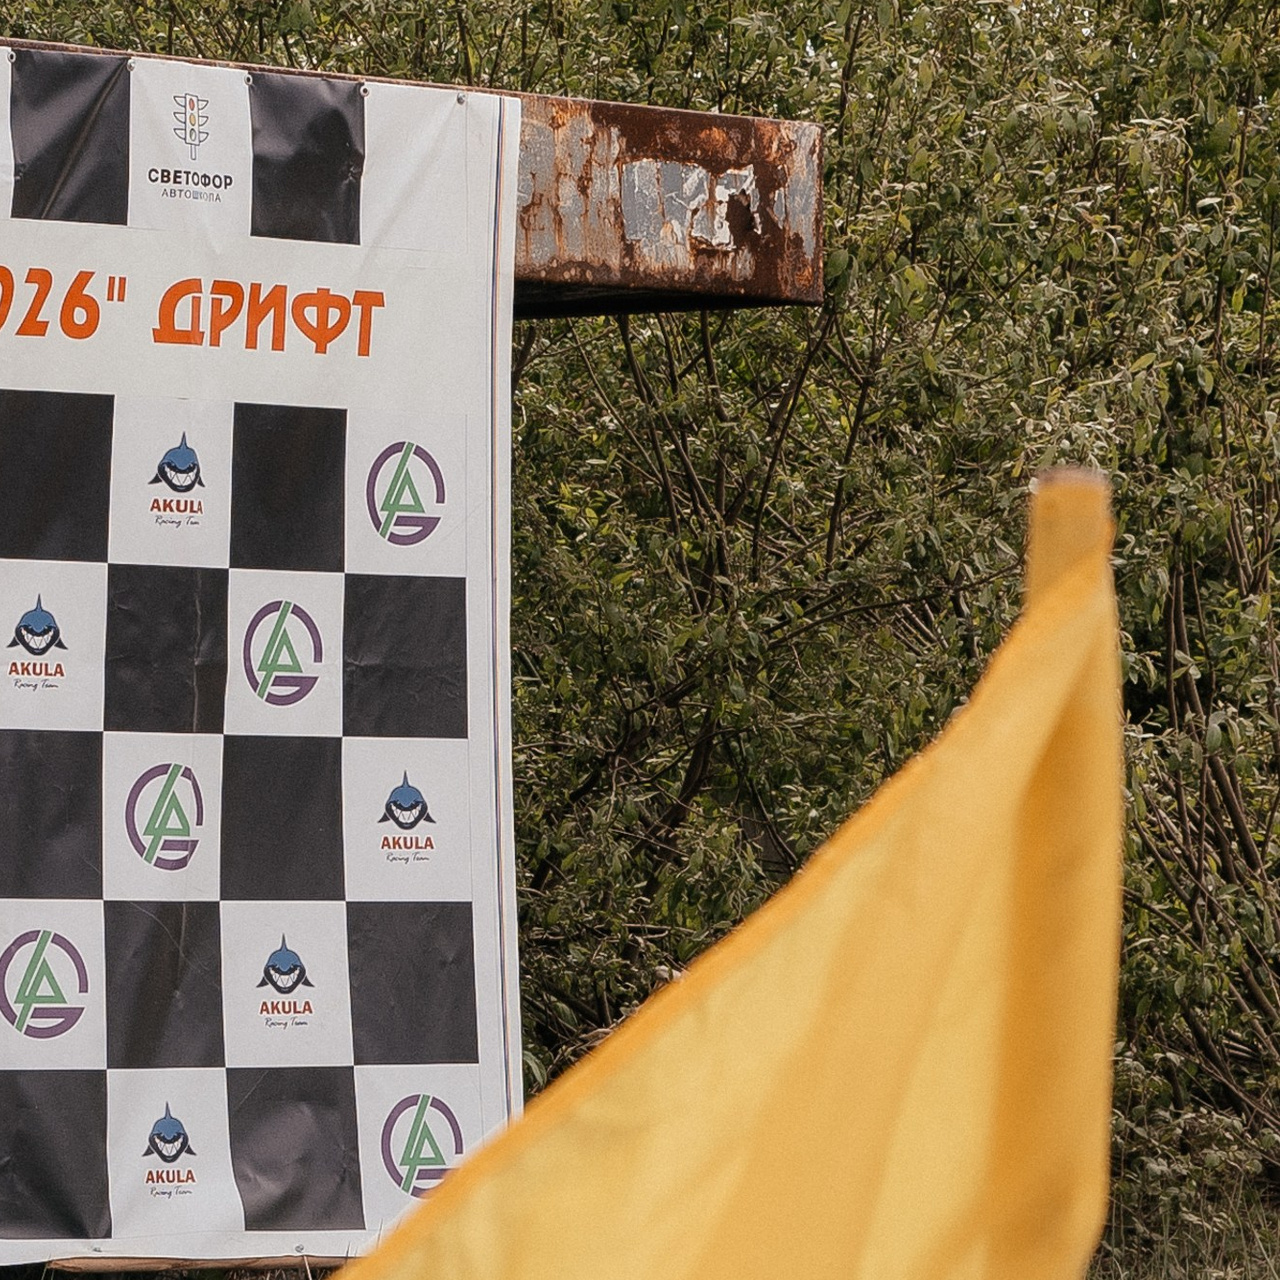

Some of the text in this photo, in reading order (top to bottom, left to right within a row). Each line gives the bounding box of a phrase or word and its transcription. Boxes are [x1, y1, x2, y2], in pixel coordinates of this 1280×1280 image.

[148, 168, 233, 190] СВЕТОФОР
[161, 188, 222, 203] АВТОШКОЛА
[152, 277, 386, 358] ДРИФТ
[150, 499, 203, 514] AKULA
[9, 661, 65, 677] AKULA
[381, 836, 434, 850] AKULA
[260, 1001, 313, 1015] AKULA
[146, 1170, 195, 1184] AKULA
